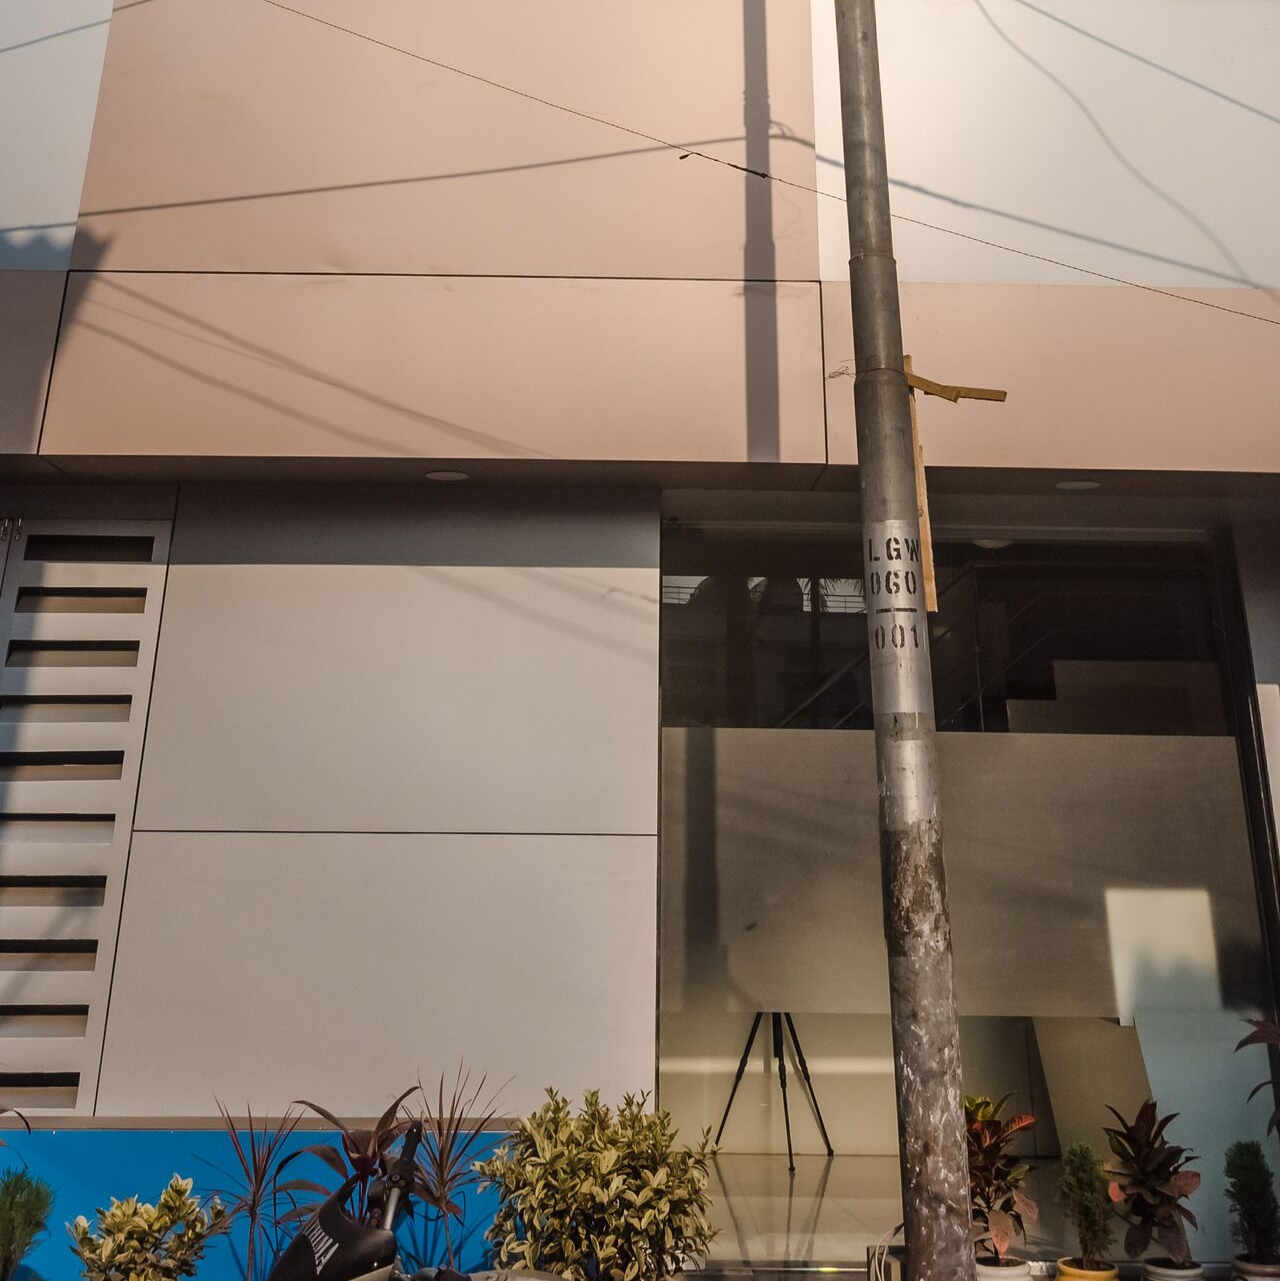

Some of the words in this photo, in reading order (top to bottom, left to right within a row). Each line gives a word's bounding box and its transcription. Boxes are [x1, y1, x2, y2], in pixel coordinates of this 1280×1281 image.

[868, 537, 919, 562] LGW
[870, 570, 917, 595] 060
[874, 623, 919, 649] 001
